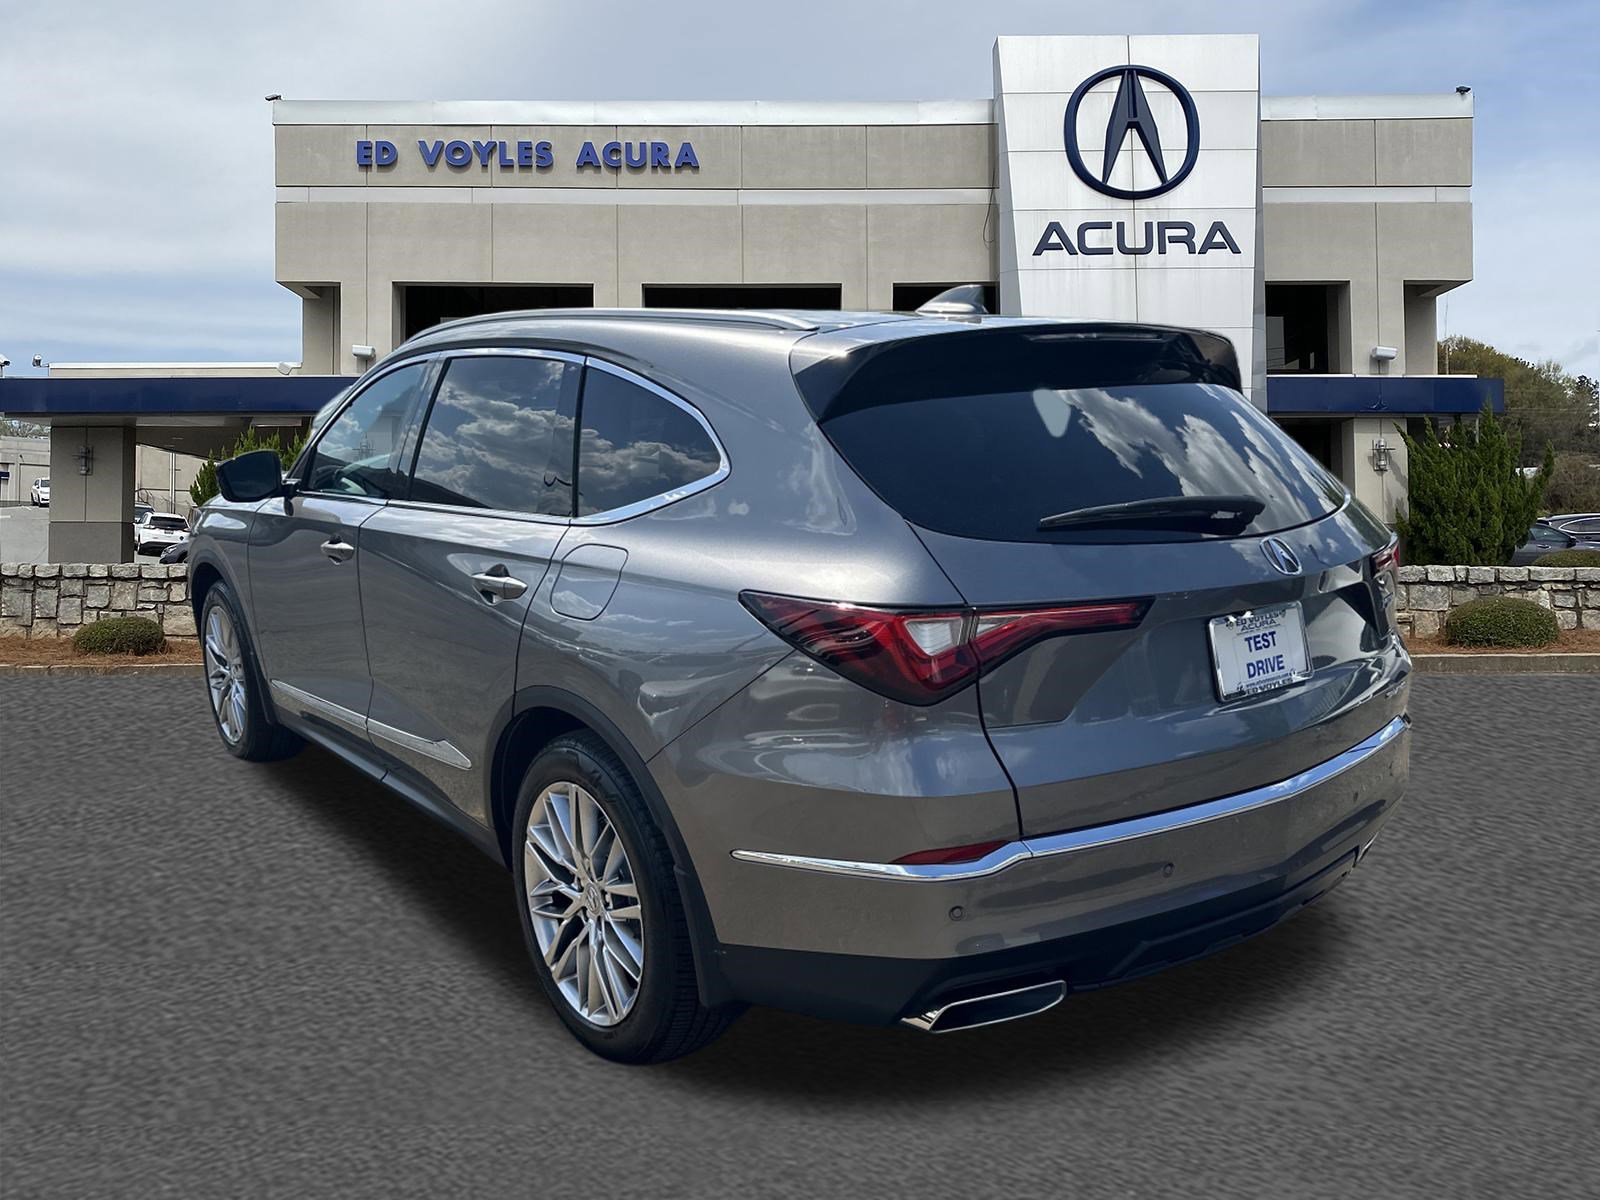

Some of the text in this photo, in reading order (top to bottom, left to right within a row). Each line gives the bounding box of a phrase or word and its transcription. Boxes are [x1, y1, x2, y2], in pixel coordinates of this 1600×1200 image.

[356, 140, 700, 168] ED VOYLES ACURA
[1032, 221, 1242, 256] ACURA
[1241, 618, 1277, 631] ACURA
[1244, 631, 1277, 653] TEST
[1246, 654, 1285, 679] DRIVE
